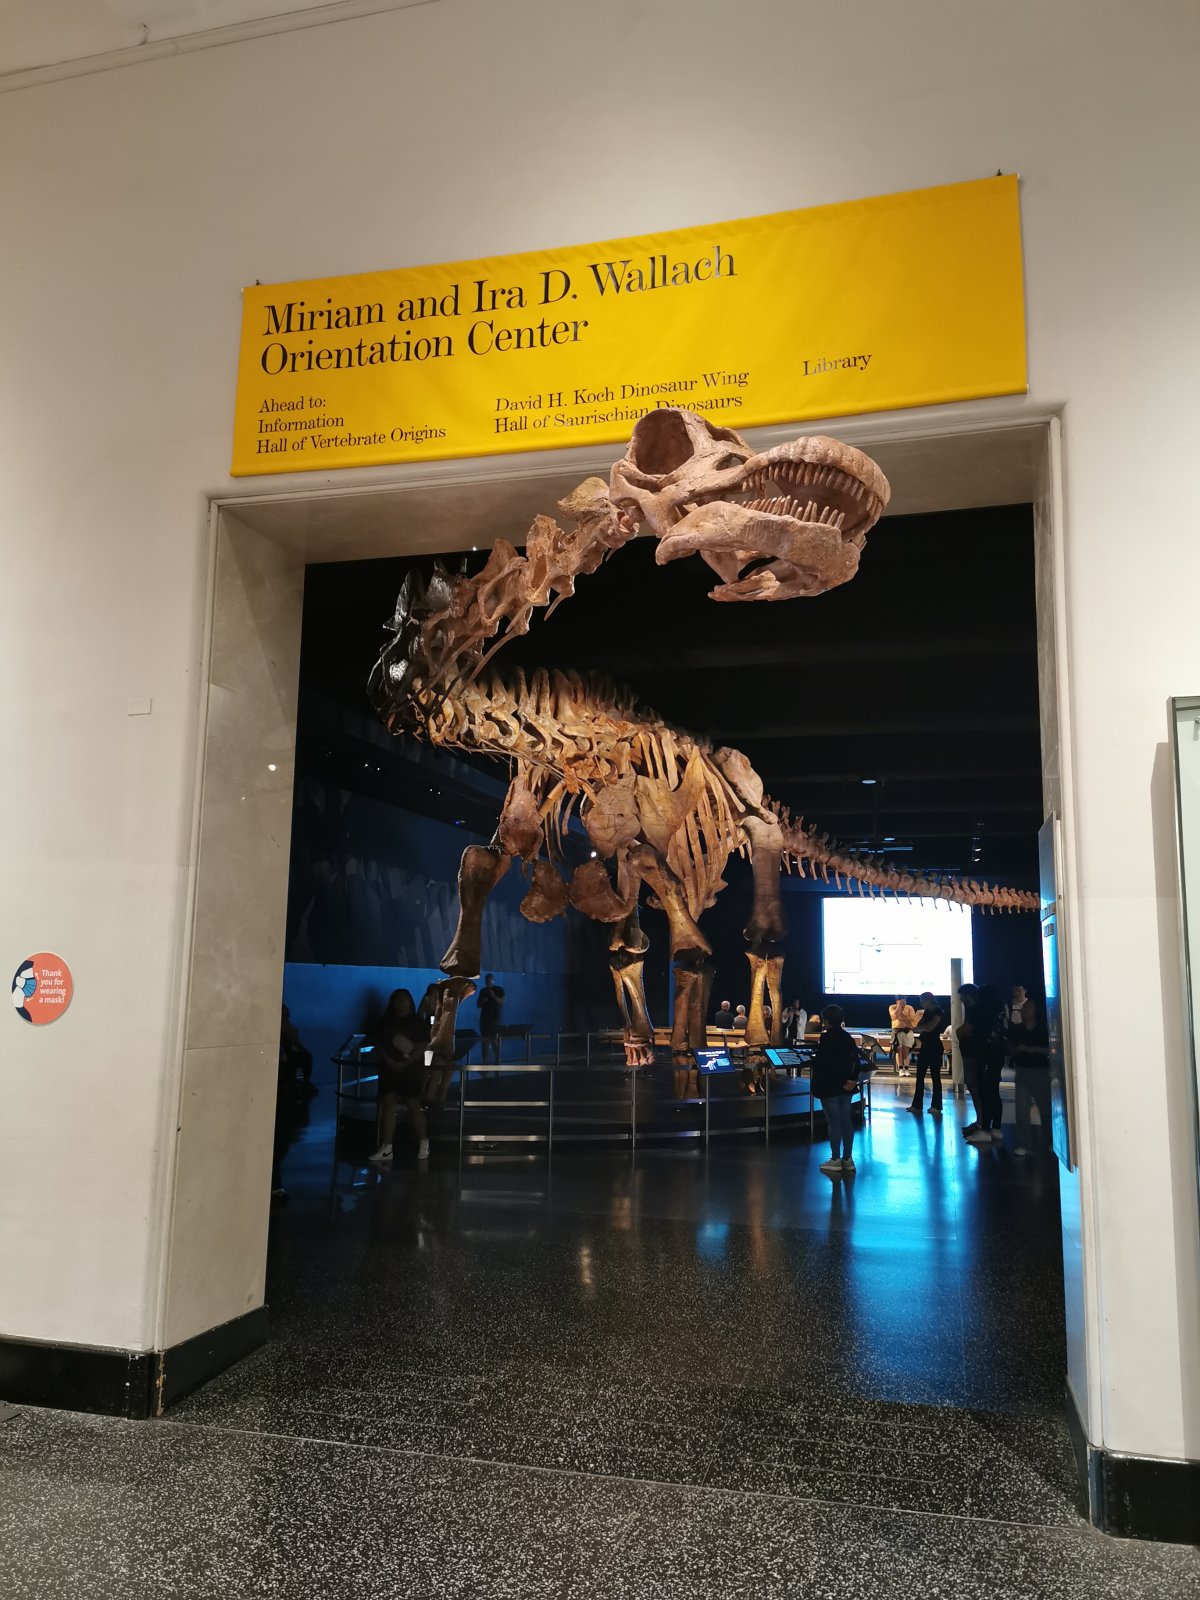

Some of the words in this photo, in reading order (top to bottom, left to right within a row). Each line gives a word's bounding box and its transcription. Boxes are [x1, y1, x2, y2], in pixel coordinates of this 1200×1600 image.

[262, 298, 387, 336] Miriam
[397, 283, 461, 322] and
[471, 279, 528, 314] Ira
[537, 269, 578, 306] D.
[586, 245, 738, 297] Wallach
[260, 329, 455, 376] Orientation
[467, 317, 589, 356] Center
[802, 354, 873, 377] Library
[495, 394, 542, 412] David
[547, 391, 569, 409] H.
[572, 387, 615, 406] Koch
[620, 379, 698, 400] Dinosaur
[702, 370, 750, 389] Wing
[257, 395, 305, 414] Ahead
[308, 396, 327, 410] to:
[257, 416, 345, 434] Information
[493, 416, 528, 434] Hall
[532, 414, 552, 429] of
[553, 406, 649, 428] Saurischian
[256, 438, 288, 454] Hall
[291, 435, 308, 452] of
[310, 432, 386, 450] Vertebrate
[390, 427, 447, 445] Origins
[40, 979, 53, 987] you
[53, 978, 64, 986] for
[41, 969, 63, 977] Thank
[39, 987, 67, 996] wearing
[44, 996, 65, 1004] mask!
